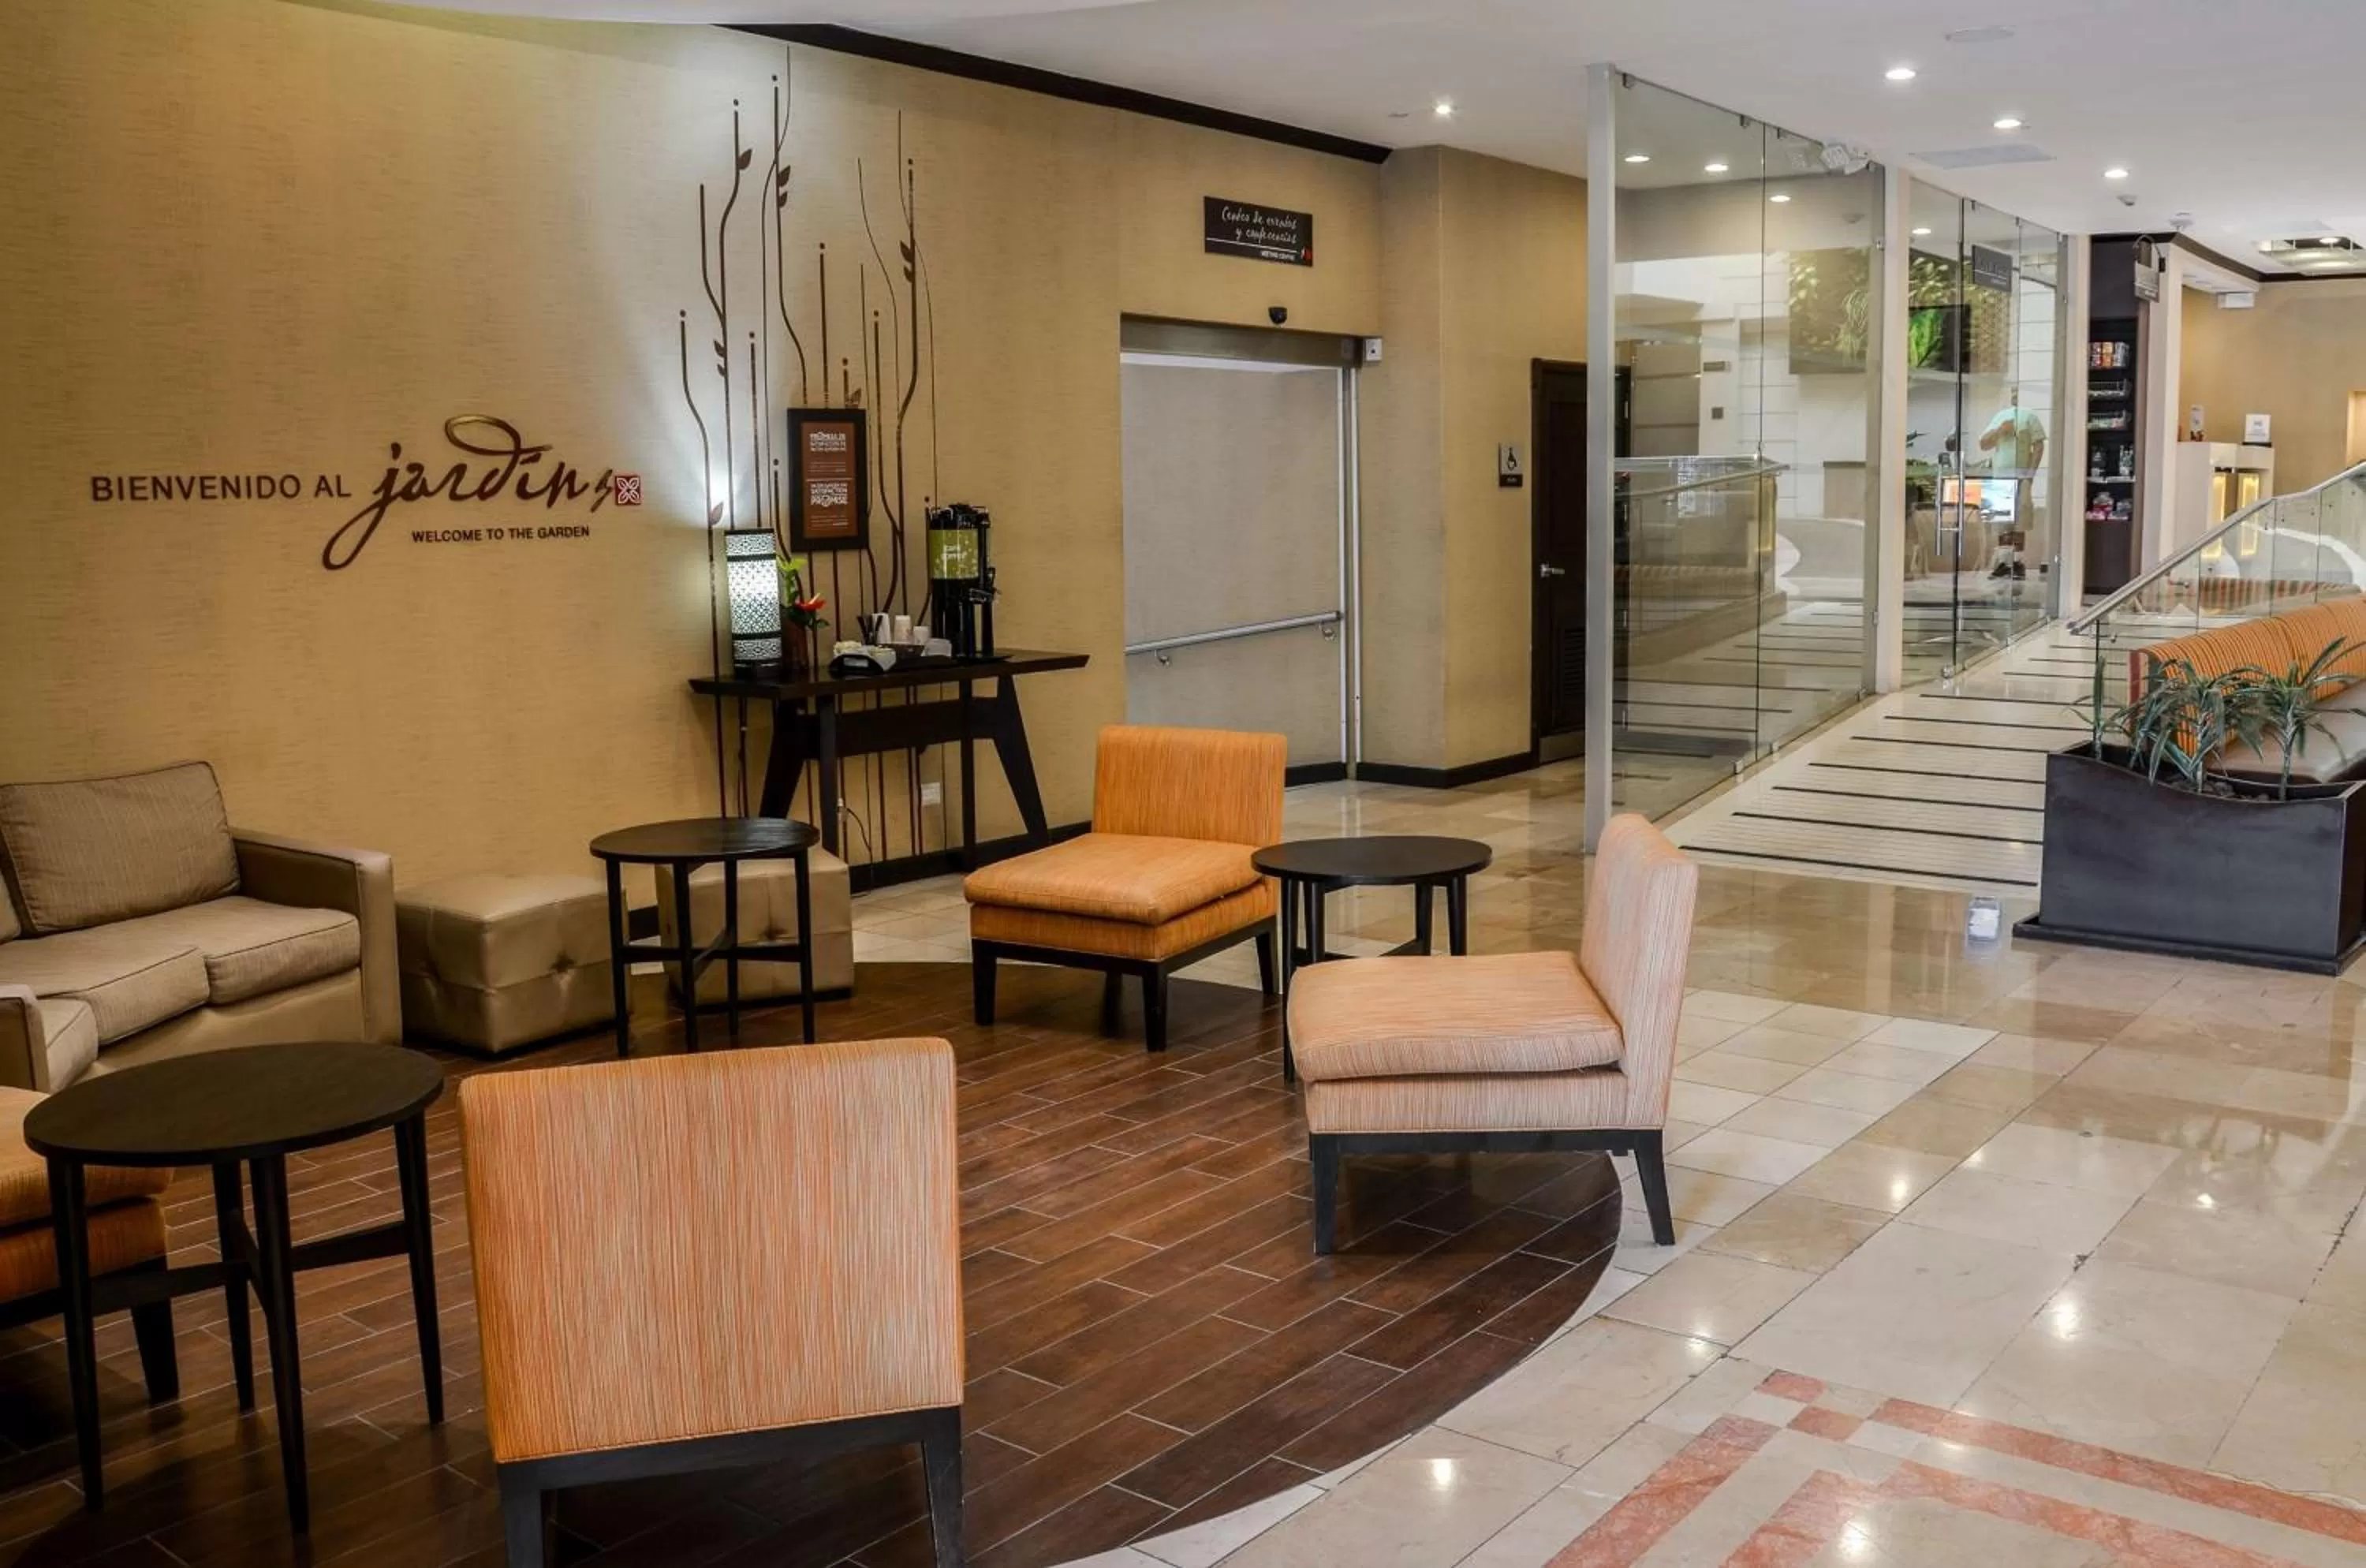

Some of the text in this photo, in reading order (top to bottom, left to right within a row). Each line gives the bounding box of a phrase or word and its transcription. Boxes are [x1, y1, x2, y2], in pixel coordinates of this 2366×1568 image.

[1221, 205, 1297, 230] Centro de eventos
[1235, 227, 1242, 241] y
[91, 474, 301, 501] BIENVENIDO
[314, 474, 352, 498] AL
[412, 526, 590, 543] WELCOME TO THE GARDEN
